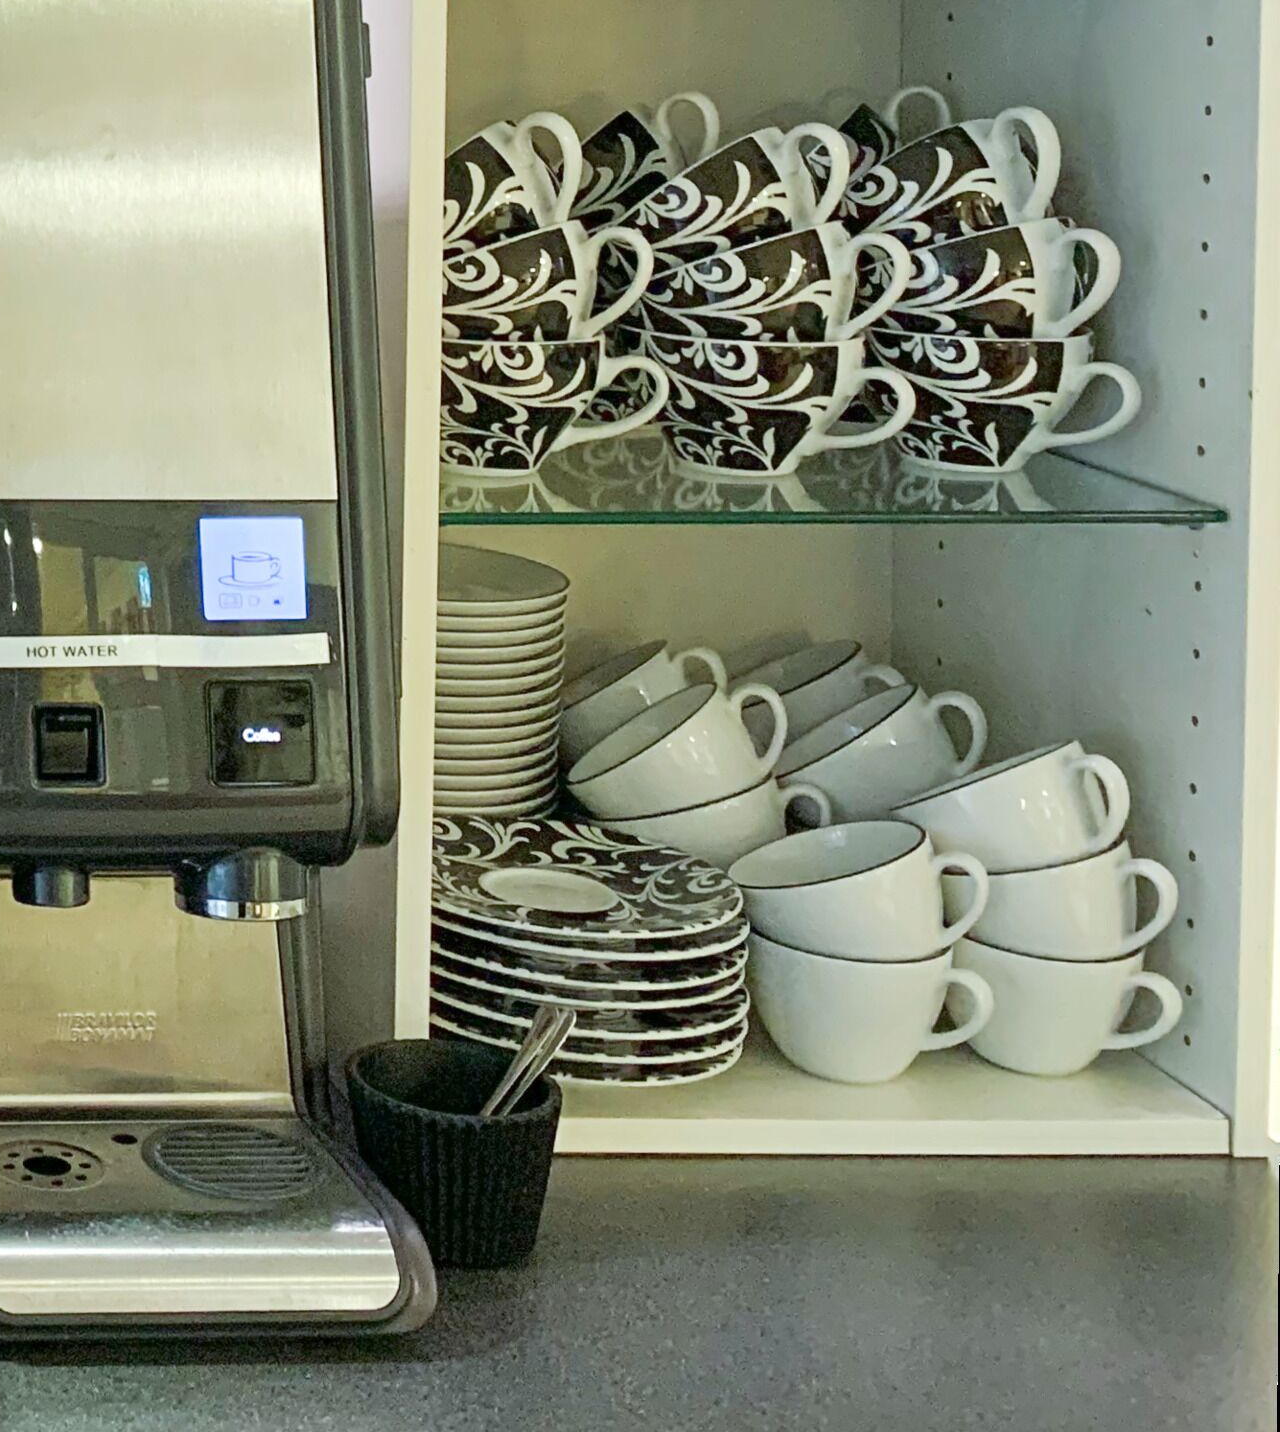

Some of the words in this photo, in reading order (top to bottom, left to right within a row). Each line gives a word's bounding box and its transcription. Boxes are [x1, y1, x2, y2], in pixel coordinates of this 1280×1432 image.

[26, 645, 58, 658] HOT
[62, 644, 119, 658] WATER
[241, 727, 282, 743] Coffee
